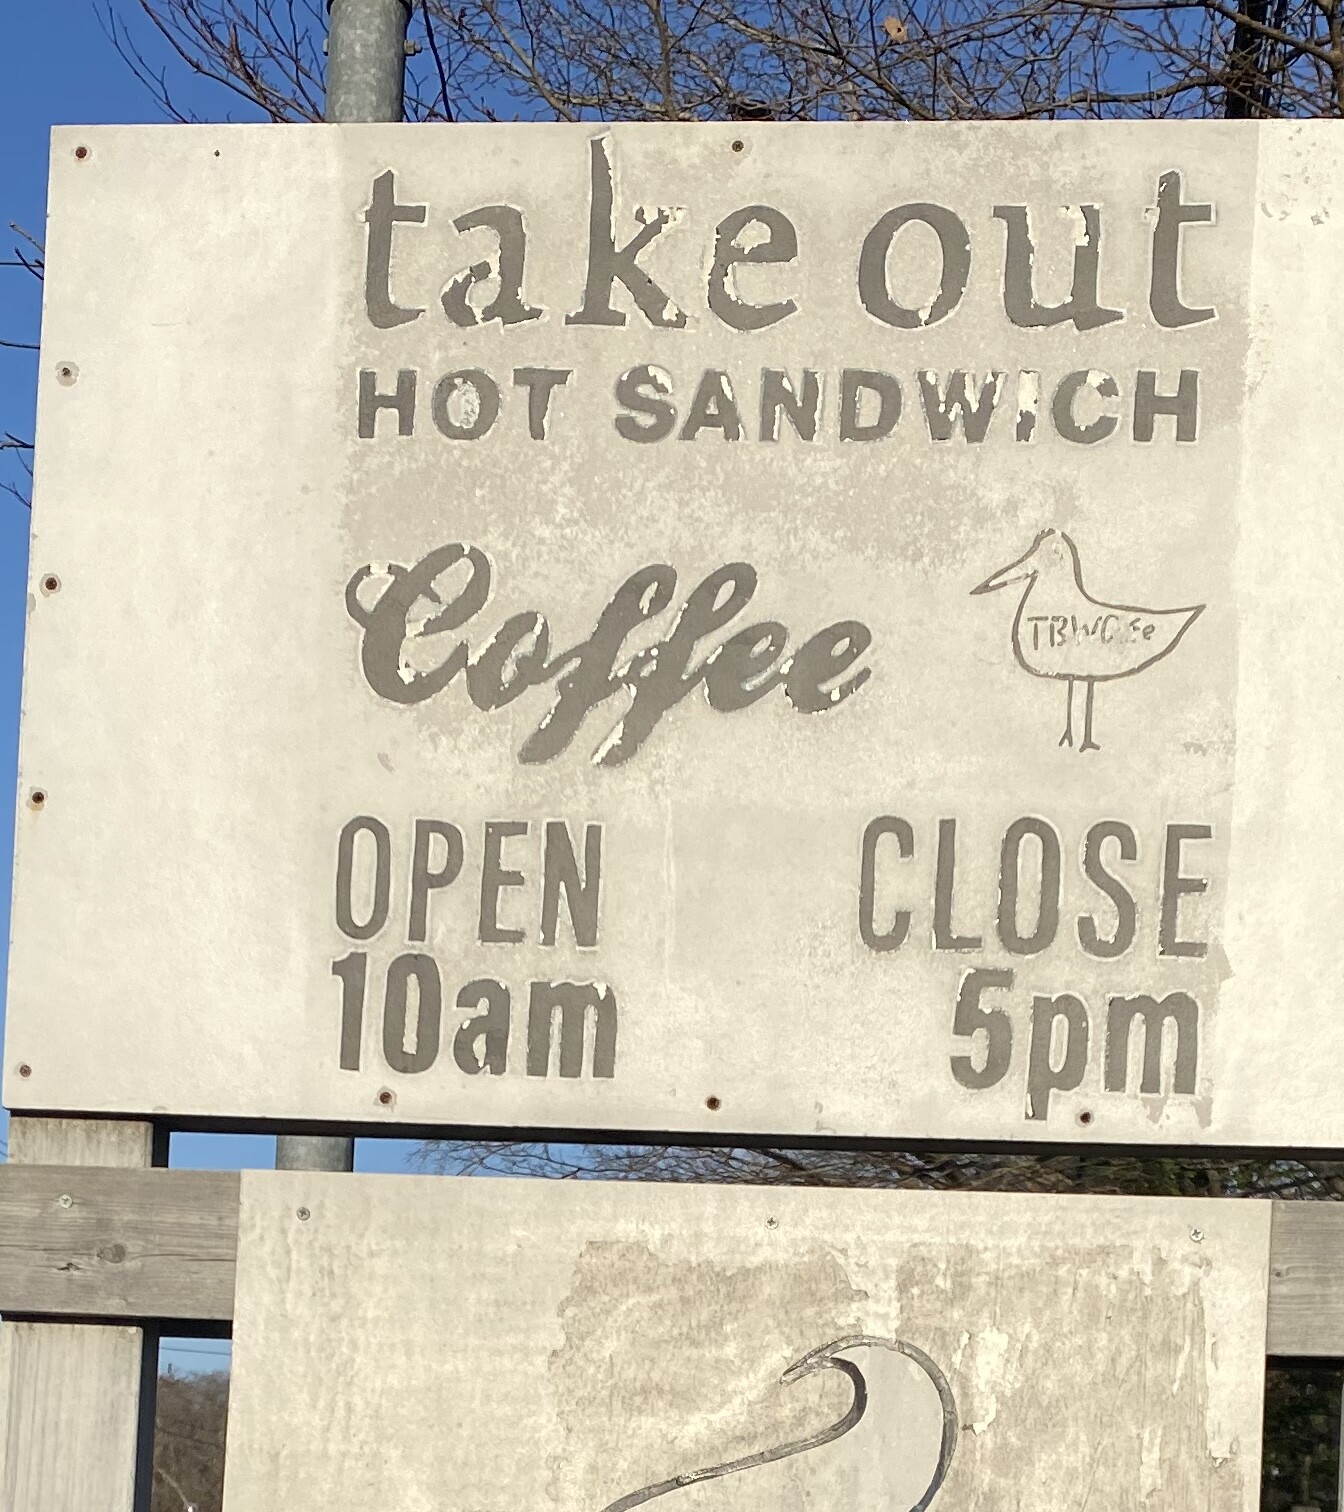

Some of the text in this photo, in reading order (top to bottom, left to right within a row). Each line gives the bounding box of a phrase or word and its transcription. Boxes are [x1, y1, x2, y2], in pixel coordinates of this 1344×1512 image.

[361, 131, 1220, 333] take out
[356, 364, 1201, 444] HOT SANDWICH
[345, 541, 873, 767] Coffee
[335, 814, 1214, 958] OPEN CLOSE
[330, 952, 1201, 1121] 10am 5pm
